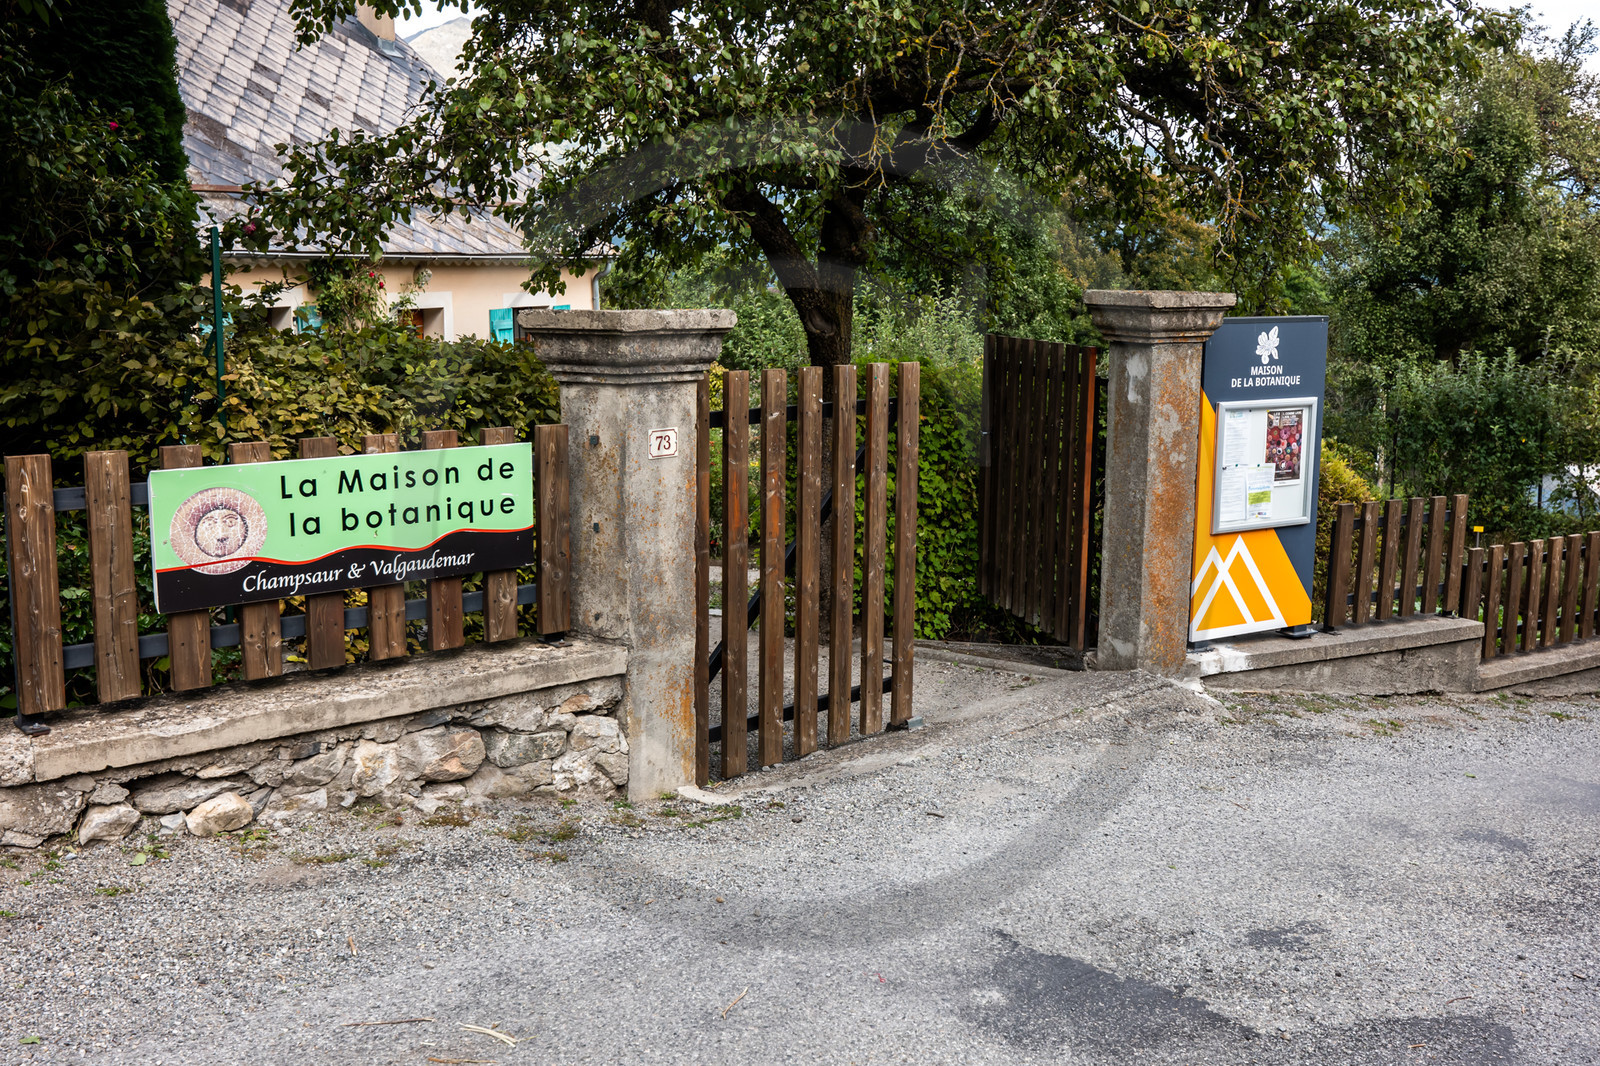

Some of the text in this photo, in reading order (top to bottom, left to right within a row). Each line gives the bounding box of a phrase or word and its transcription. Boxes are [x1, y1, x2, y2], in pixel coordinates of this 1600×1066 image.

[1231, 375, 1301, 388] DE LA BOTANIQUE
[1250, 365, 1283, 376] MAISON
[655, 435, 671, 451] 73
[280, 457, 516, 500] La Maison de
[289, 496, 516, 537] la botanique
[242, 549, 476, 596] Champsaur & Valgaudemar
